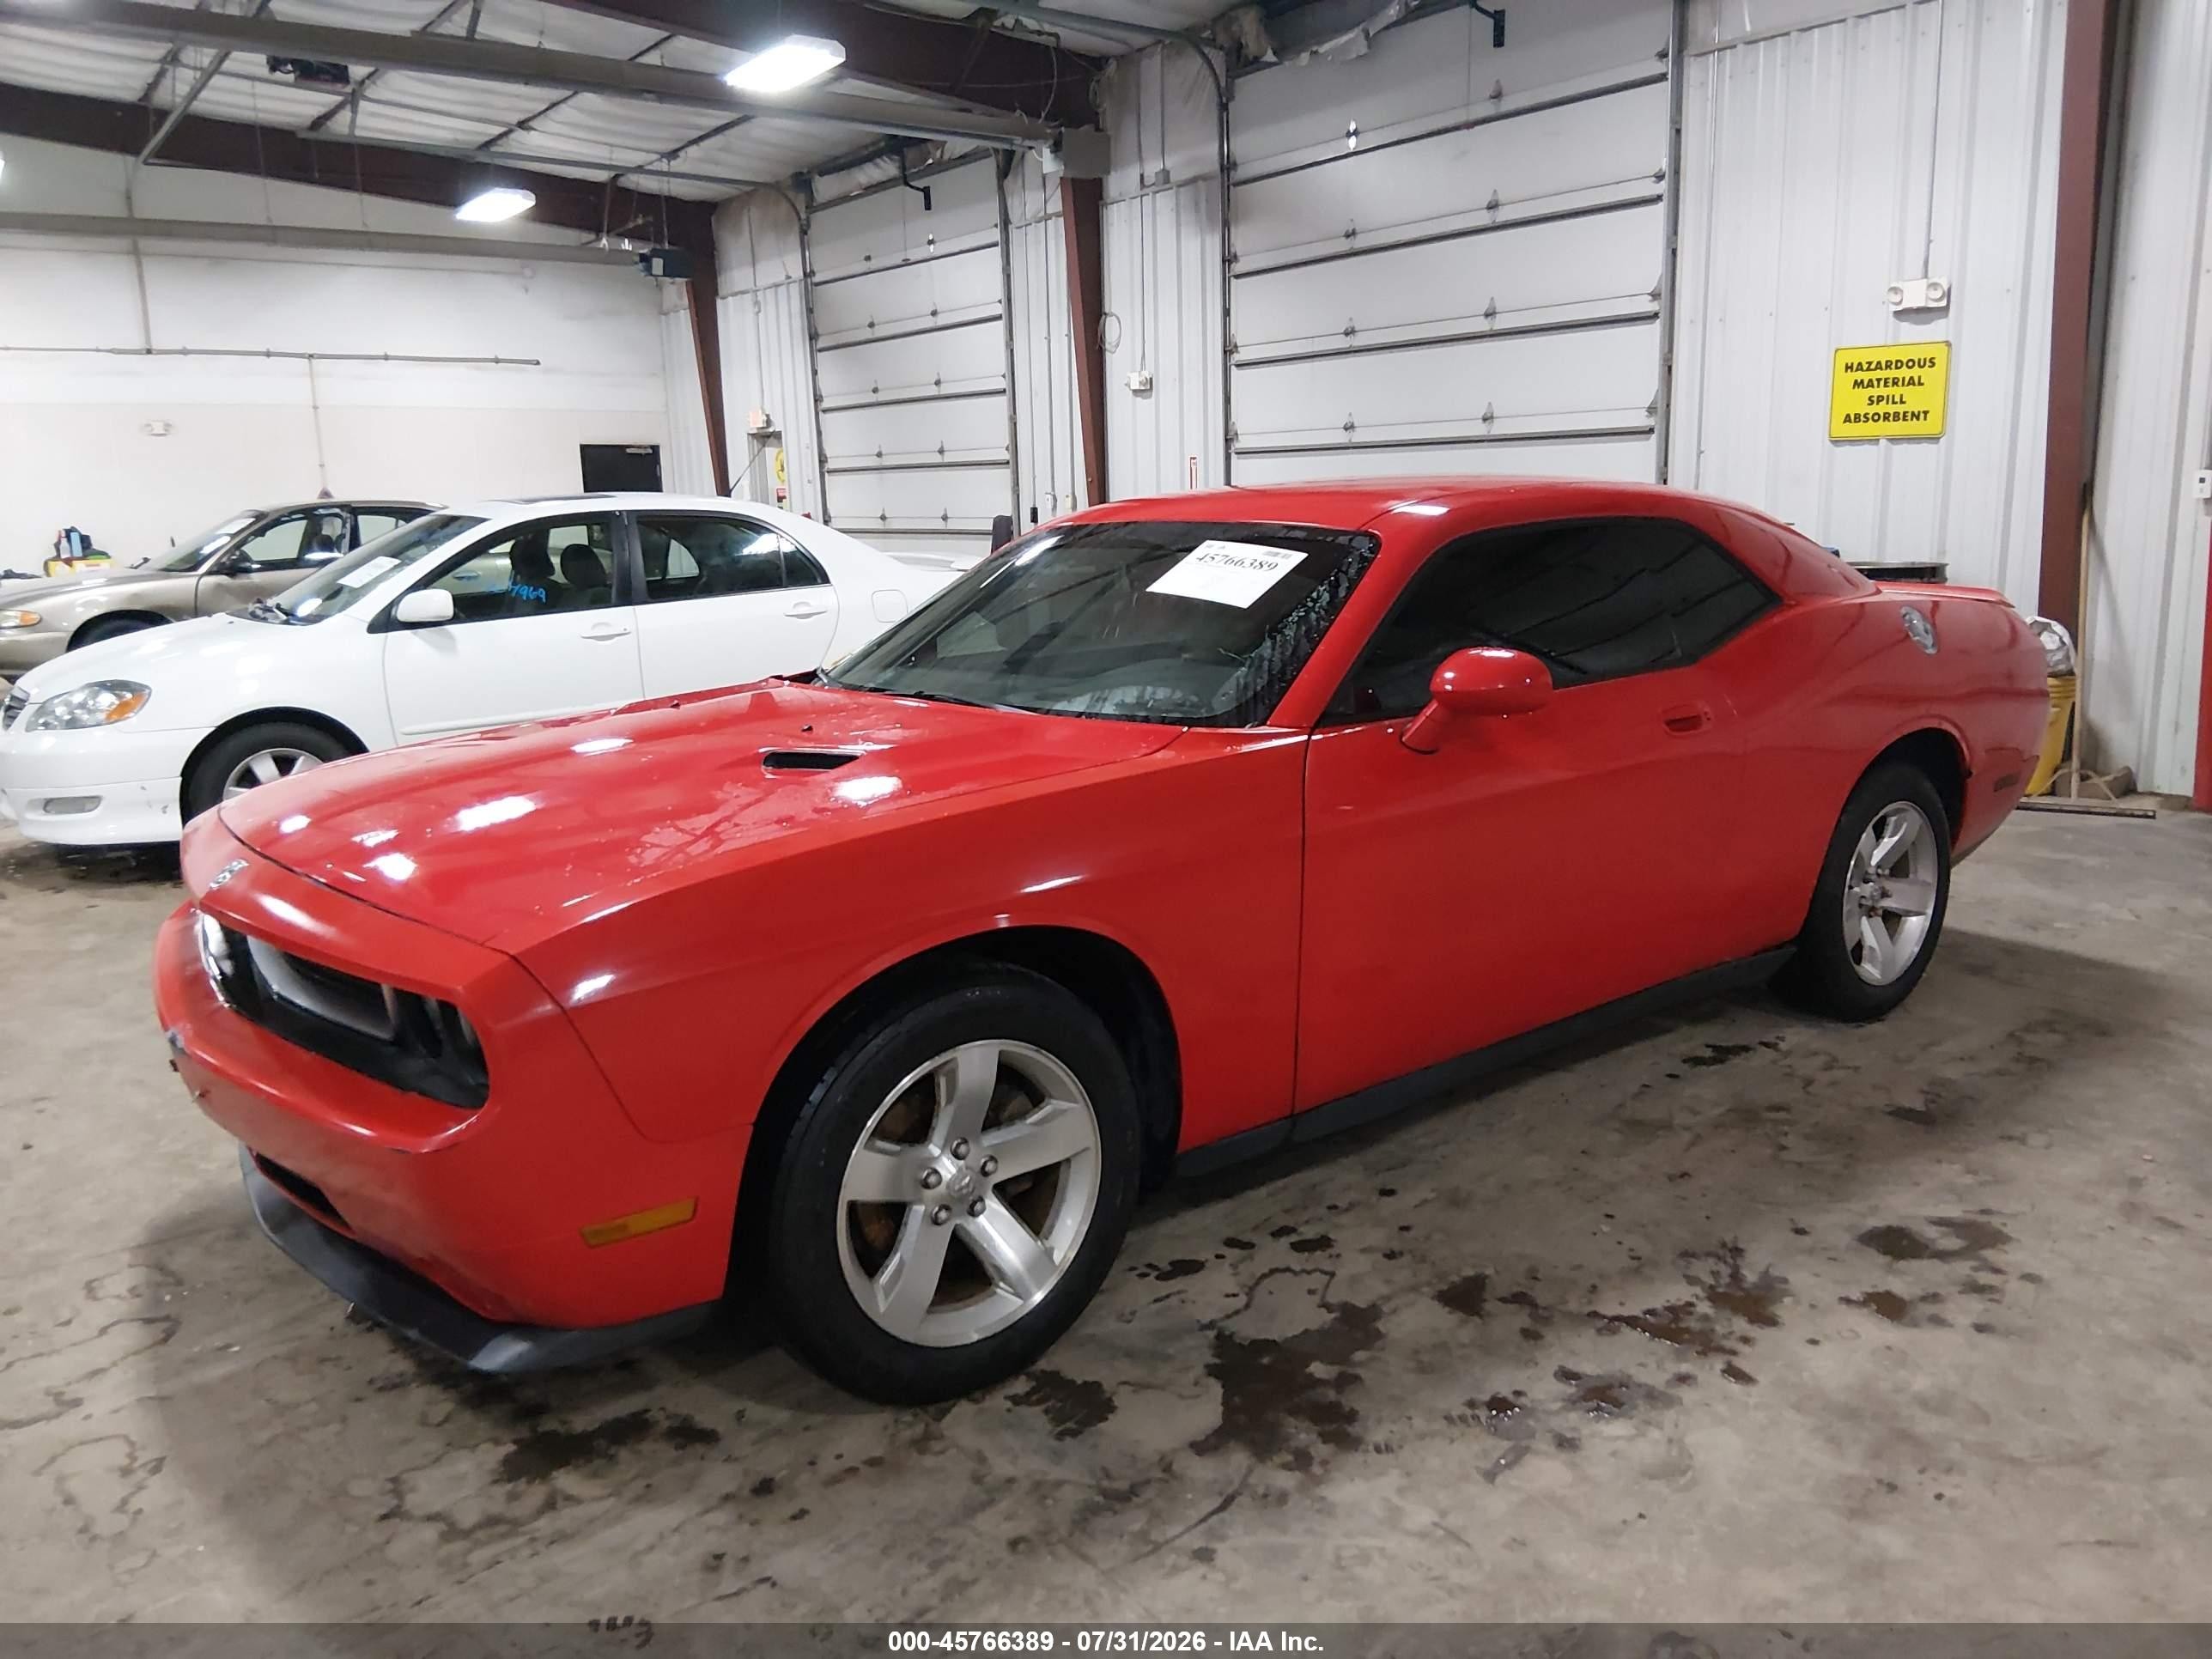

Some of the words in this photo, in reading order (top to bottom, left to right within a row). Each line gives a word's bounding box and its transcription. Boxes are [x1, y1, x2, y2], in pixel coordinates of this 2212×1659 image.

[1844, 357, 1936, 373] HAZARDOUS
[1852, 375, 1925, 390] MATERIAL
[1867, 394, 1906, 406] SPILL
[1842, 410, 1929, 424] ABSORBENT
[1195, 552, 1279, 572] 45766389
